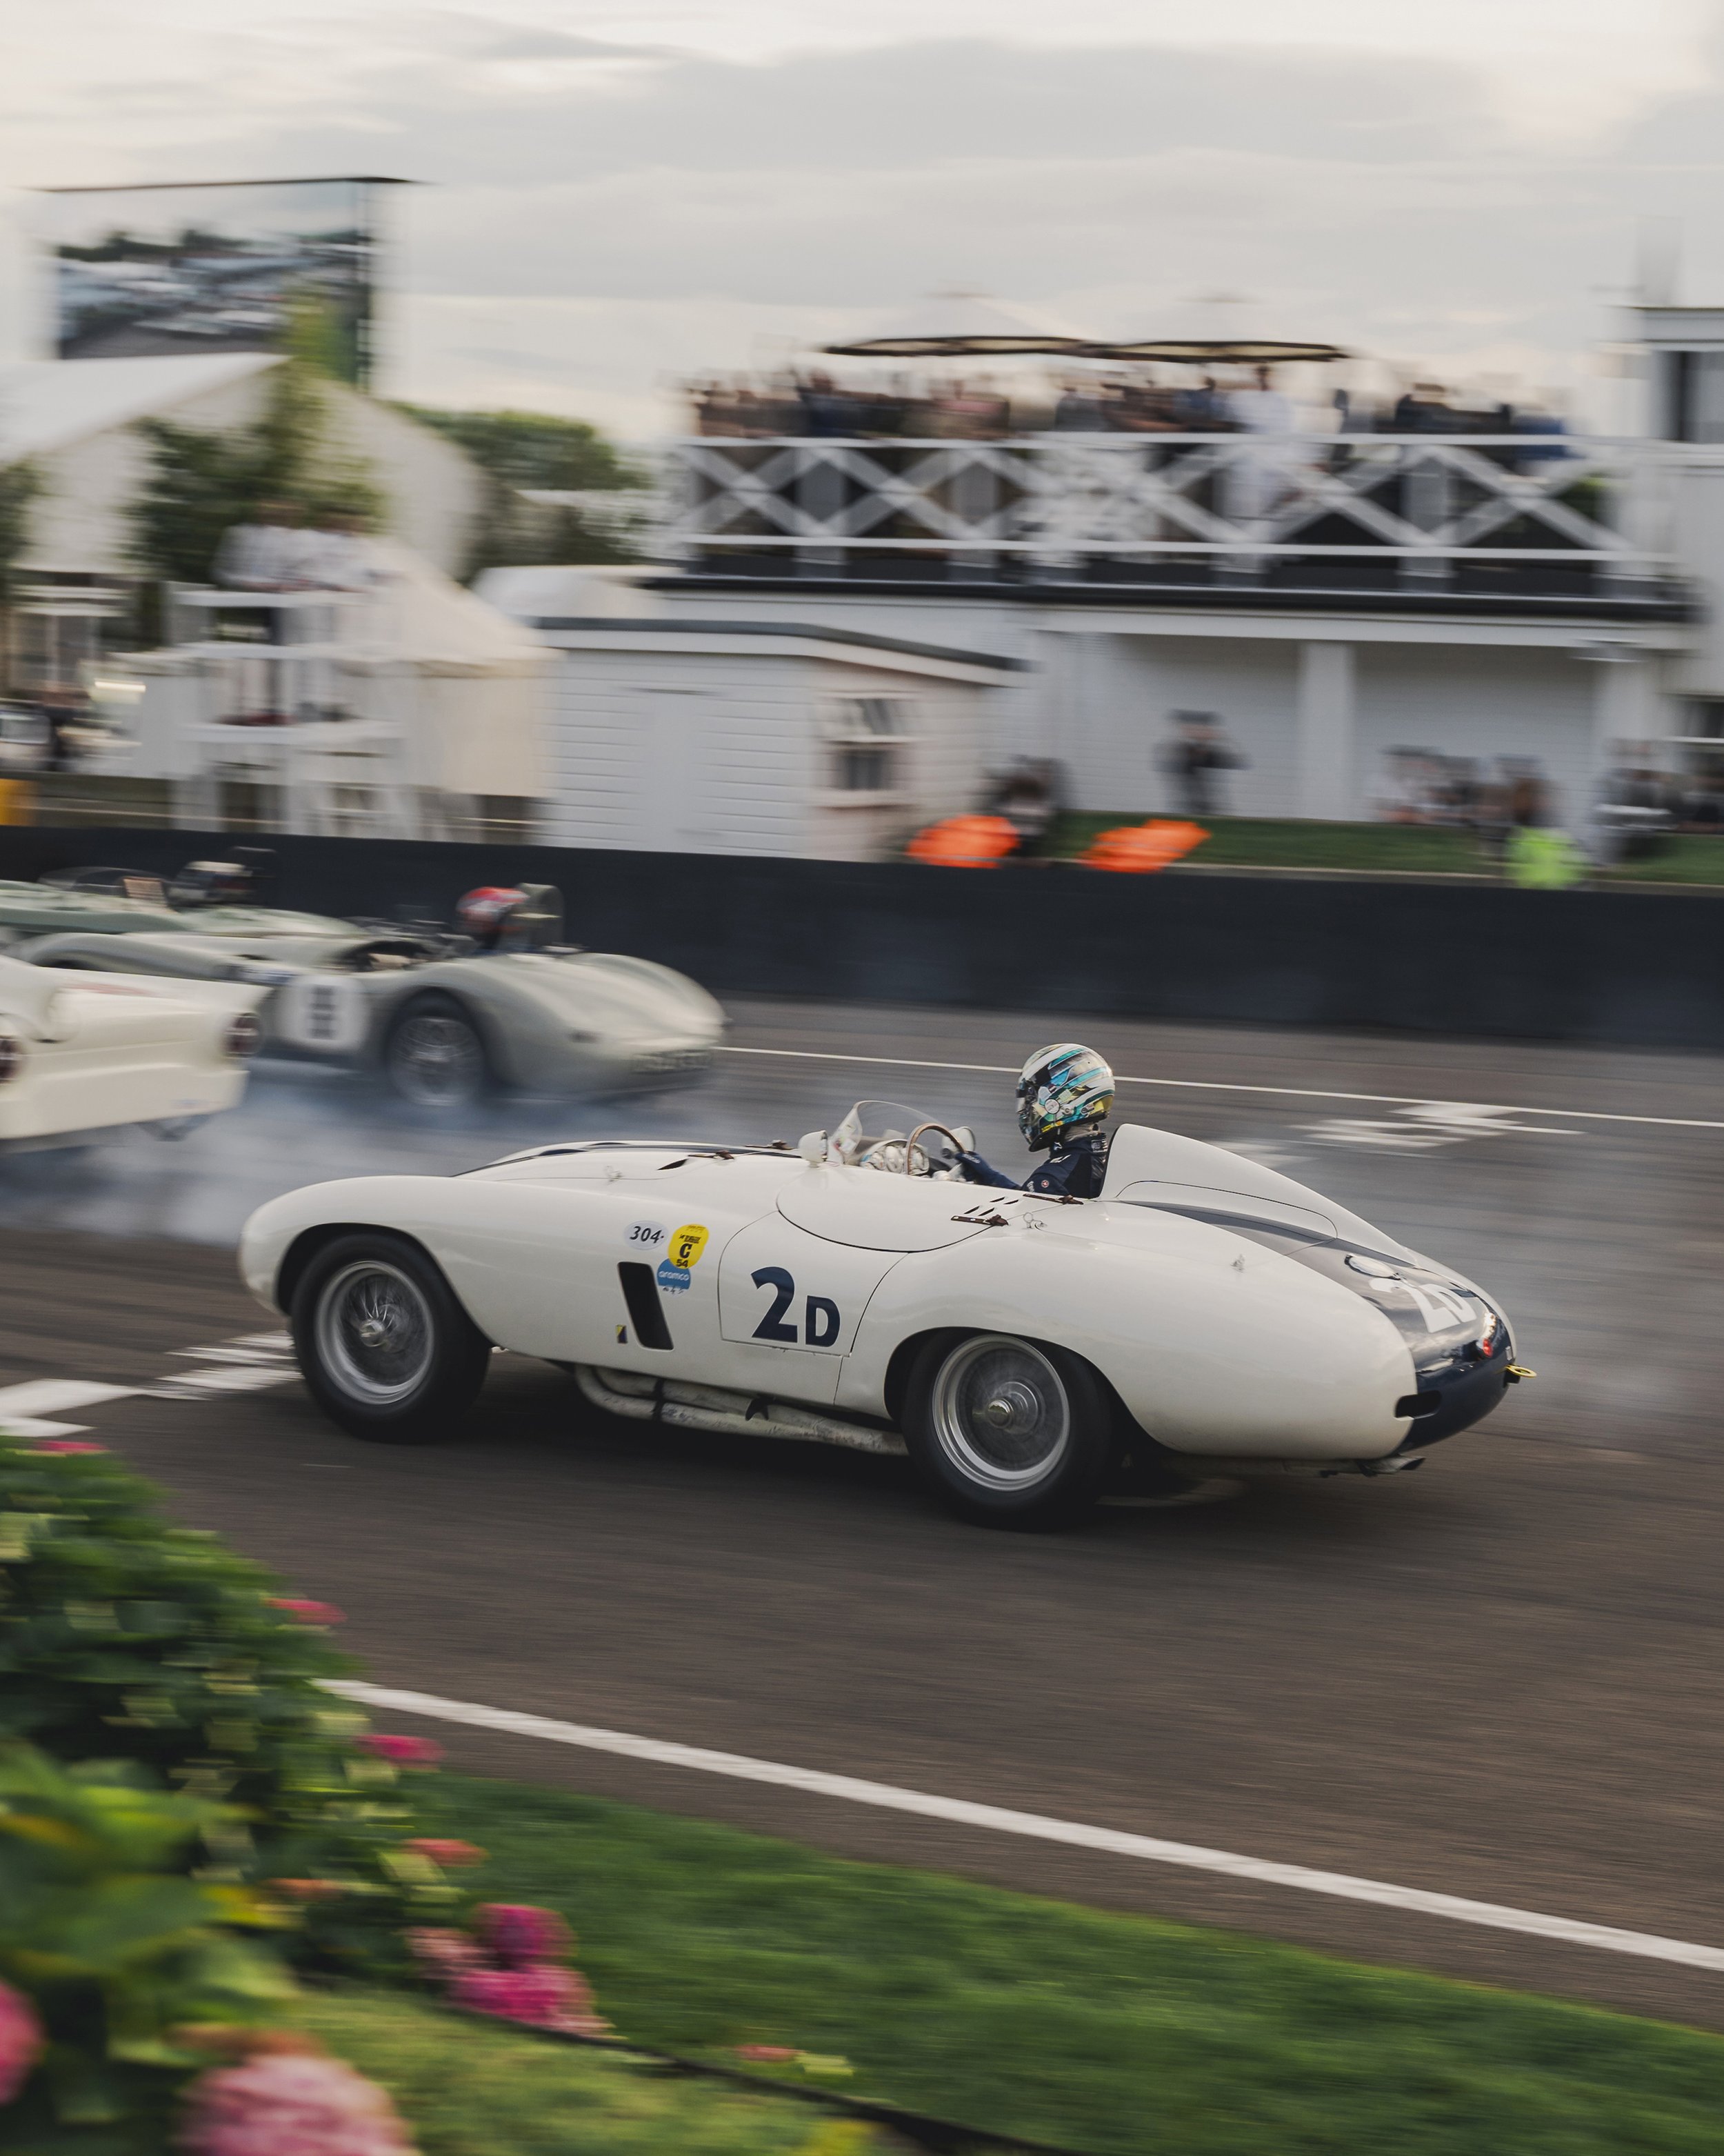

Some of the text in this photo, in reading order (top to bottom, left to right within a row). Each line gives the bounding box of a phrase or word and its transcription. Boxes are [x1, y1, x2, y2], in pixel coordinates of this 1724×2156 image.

[630, 1226, 663, 1244] 304
[679, 1243, 692, 1259] C
[676, 1259, 688, 1268] 54
[658, 1270, 690, 1281] aramco
[750, 1266, 841, 1348] 2D
